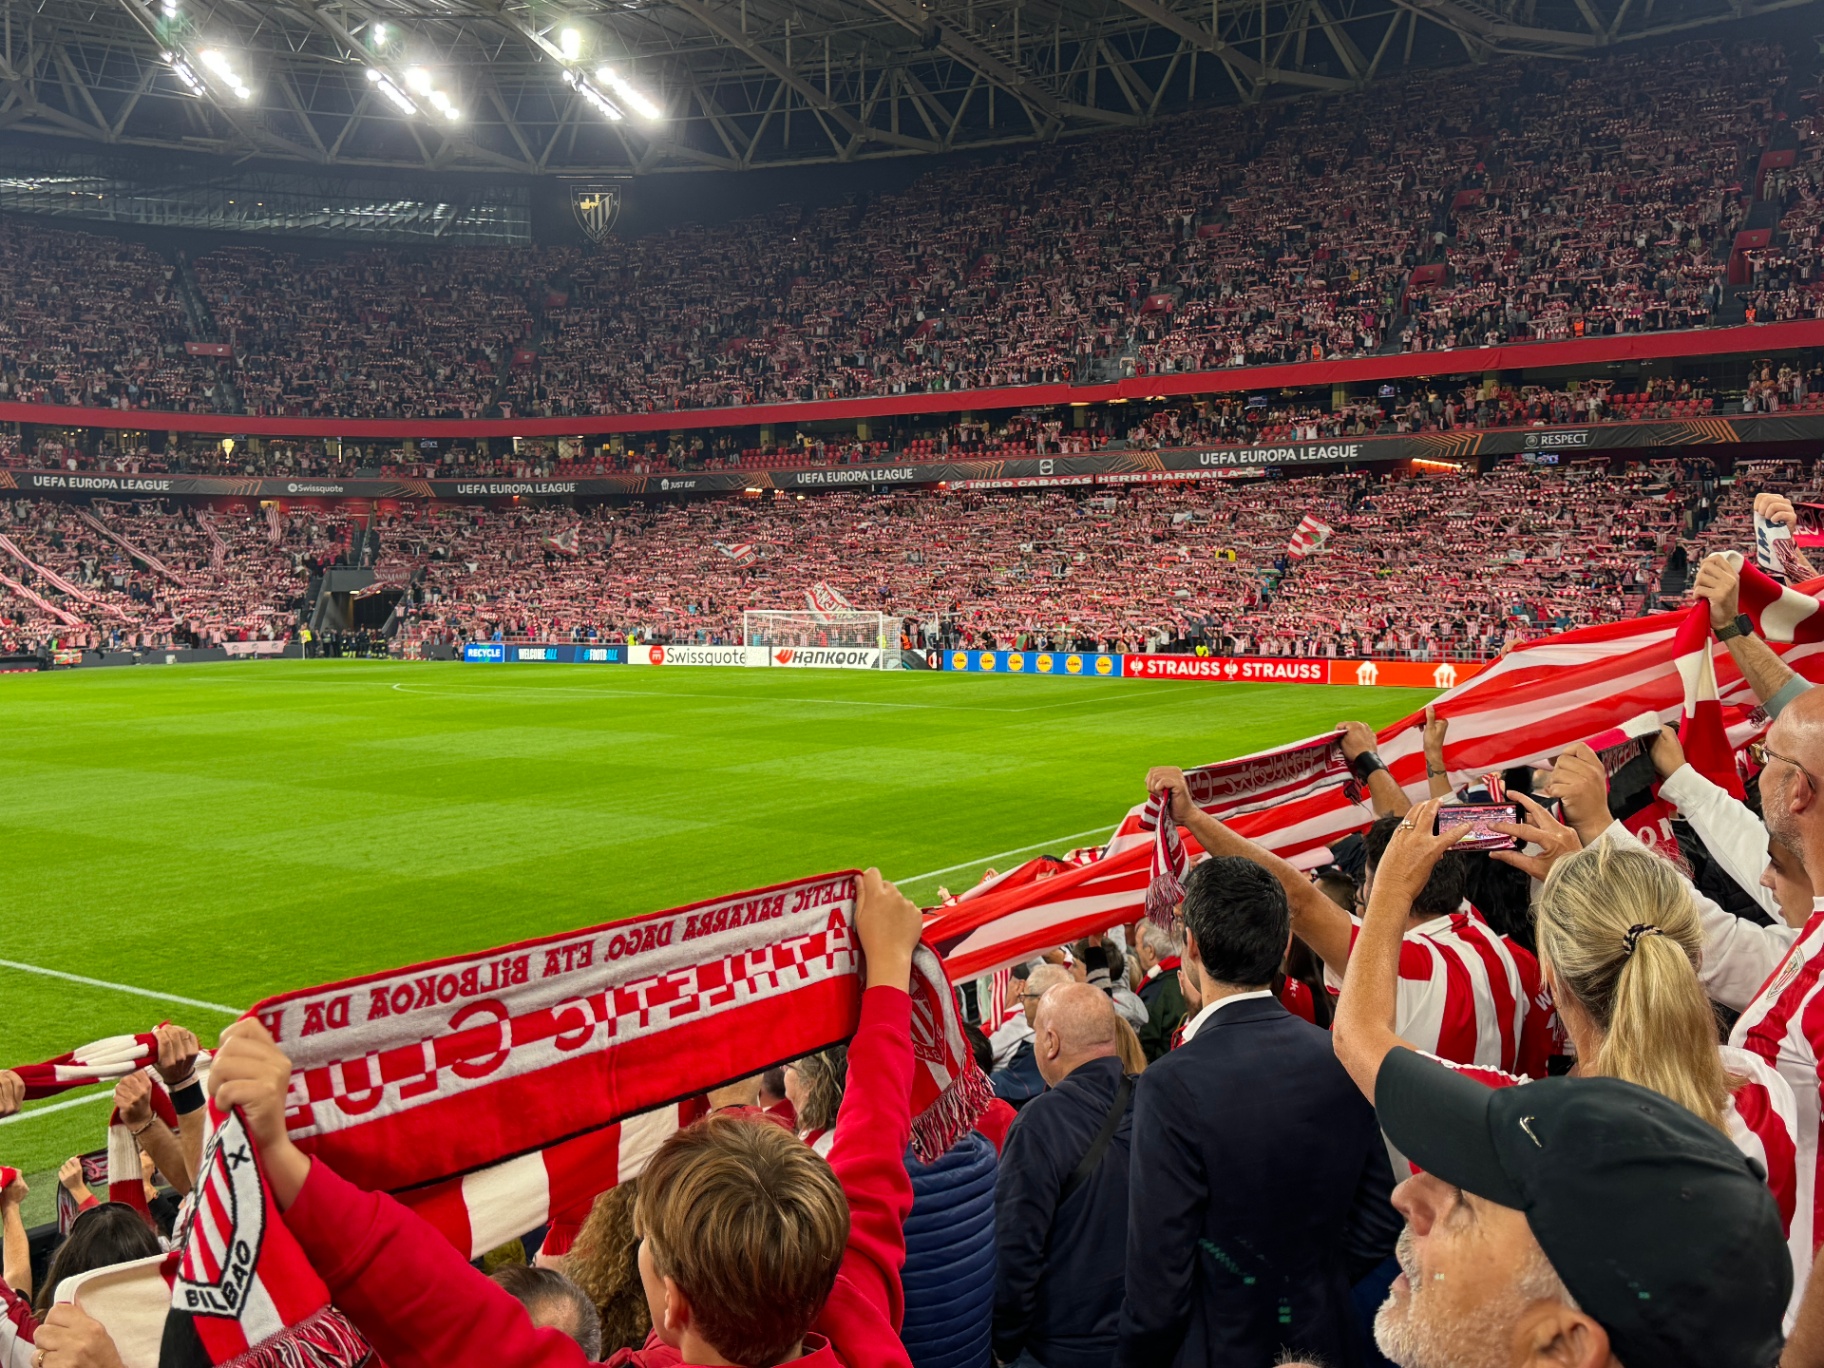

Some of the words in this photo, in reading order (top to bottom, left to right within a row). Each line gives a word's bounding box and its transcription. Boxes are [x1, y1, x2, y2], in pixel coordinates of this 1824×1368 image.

[1541, 433, 1588, 445] RESPECT
[1200, 452, 1237, 466] UEFA
[1239, 448, 1297, 464] EUROPA
[1300, 444, 1359, 460] LEAGUE
[33, 475, 66, 488] UEFA
[69, 477, 118, 489] EUROPA
[121, 479, 170, 491] LEAGUE
[797, 472, 825, 484] UEFA
[827, 470, 868, 483] EUROPA
[871, 468, 914, 481] LEAGUE
[1017, 477, 1092, 487] CABACAS
[1098, 474, 1147, 484] HERRI
[1151, 469, 1239, 481] HARMAILA
[298, 483, 344, 494] Swissquote
[457, 484, 488, 494] UEFA
[490, 483, 533, 494] EUROPA
[535, 482, 576, 493] LEAGUE
[670, 481, 684, 489] JUST
[467, 648, 501, 658] RECYCLE
[666, 647, 745, 666] Swissquote
[792, 650, 869, 666] HANKOOK
[1146, 660, 1221, 676] STRAUSS
[1242, 662, 1321, 679] STRAUSS
[185, 1240, 251, 1311] BILBAO
